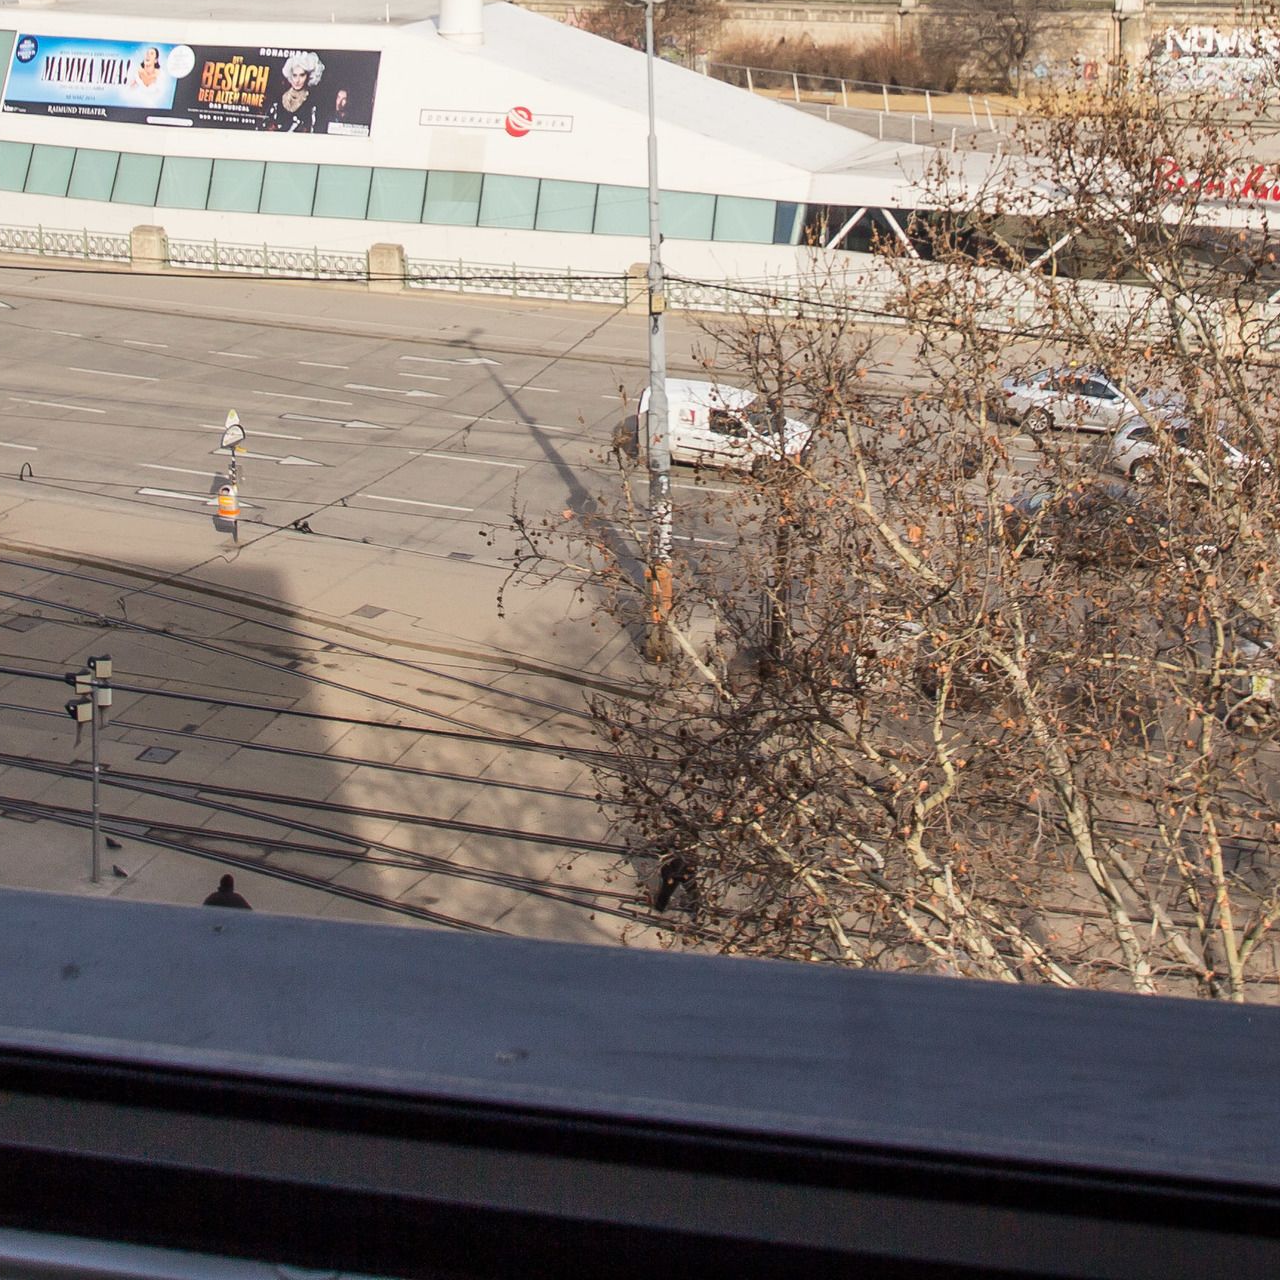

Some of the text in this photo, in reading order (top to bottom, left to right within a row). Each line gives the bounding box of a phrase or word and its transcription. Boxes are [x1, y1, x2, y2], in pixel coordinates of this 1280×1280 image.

[42, 56, 132, 85] MAMMA MIA!
[201, 61, 269, 93] BESUCH
[198, 88, 266, 107] DER ALTEN DAME
[47, 105, 108, 117] RAIMUND THEATER
[223, 103, 250, 112] MUSICAL
[427, 114, 566, 128] DONAURAUM WIEN
